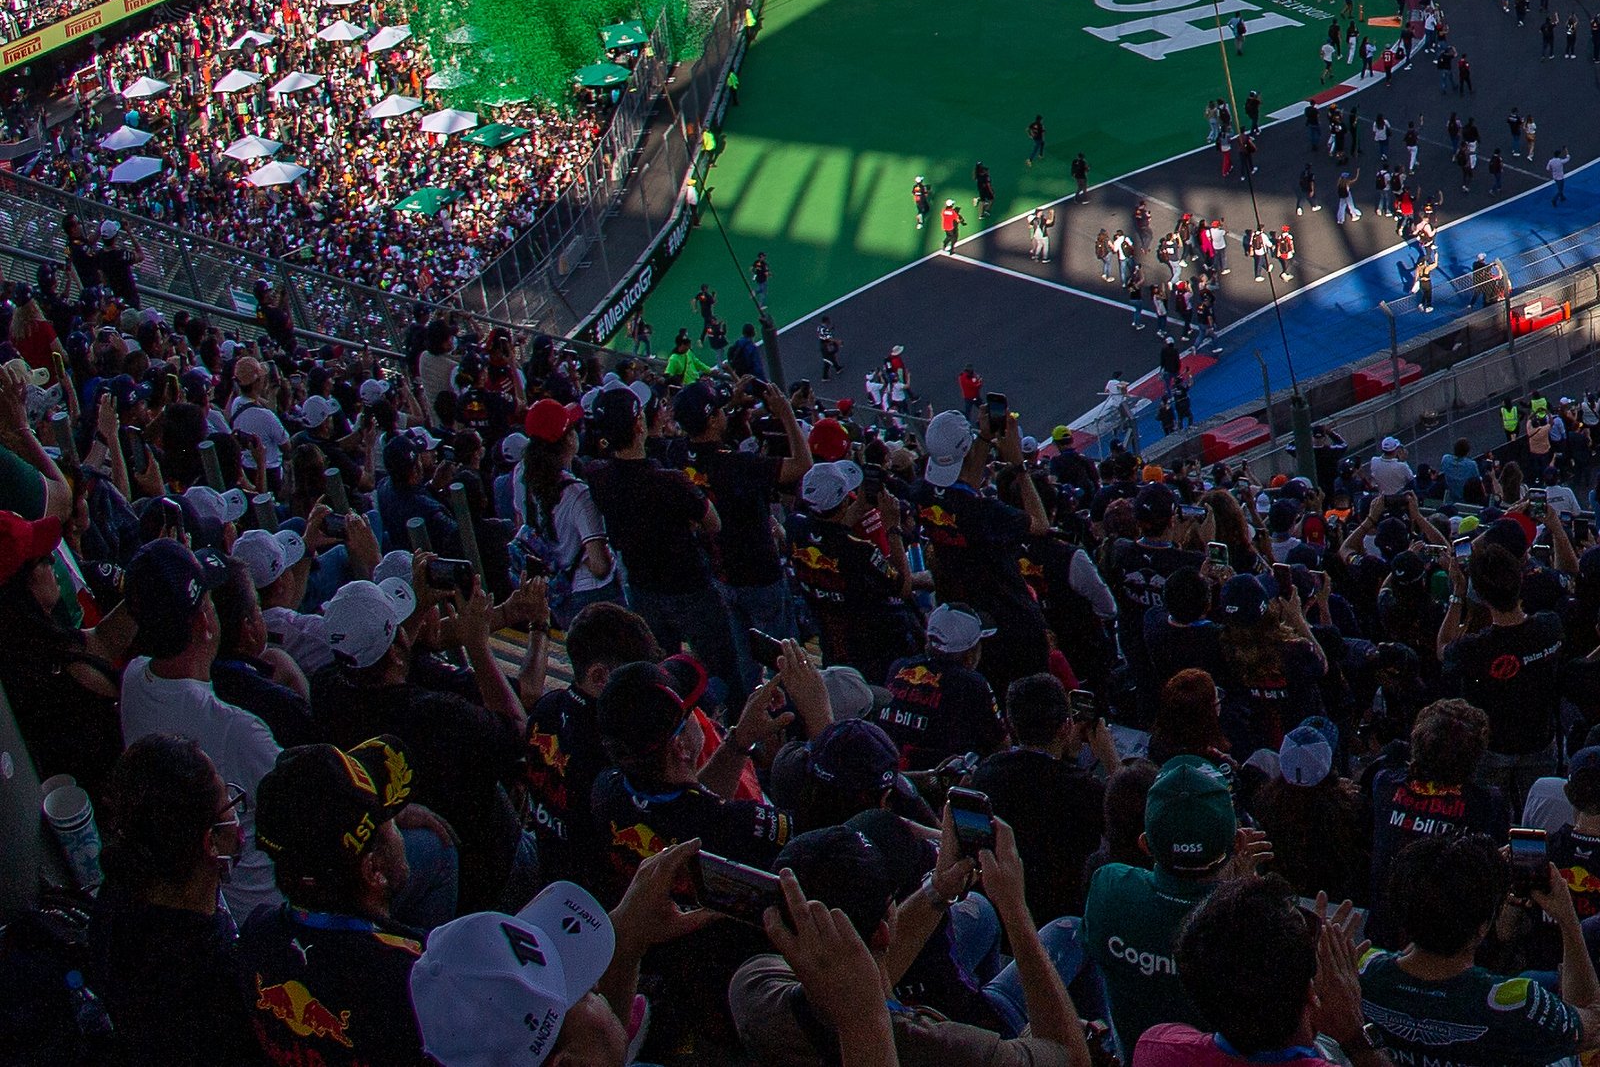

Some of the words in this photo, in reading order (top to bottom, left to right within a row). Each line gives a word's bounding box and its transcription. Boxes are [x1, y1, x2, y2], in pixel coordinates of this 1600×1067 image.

[65, 11, 102, 37] PIRELLI
[3, 36, 42, 65] PIRELLI
[879, 708, 913, 728] Mbil
[341, 812, 377, 855] 1ST
[1570, 831, 1600, 844] HONDA
[1172, 842, 1204, 854] BOSS
[1107, 936, 1178, 977] Cogni
[529, 1008, 559, 1057] BANORTE
